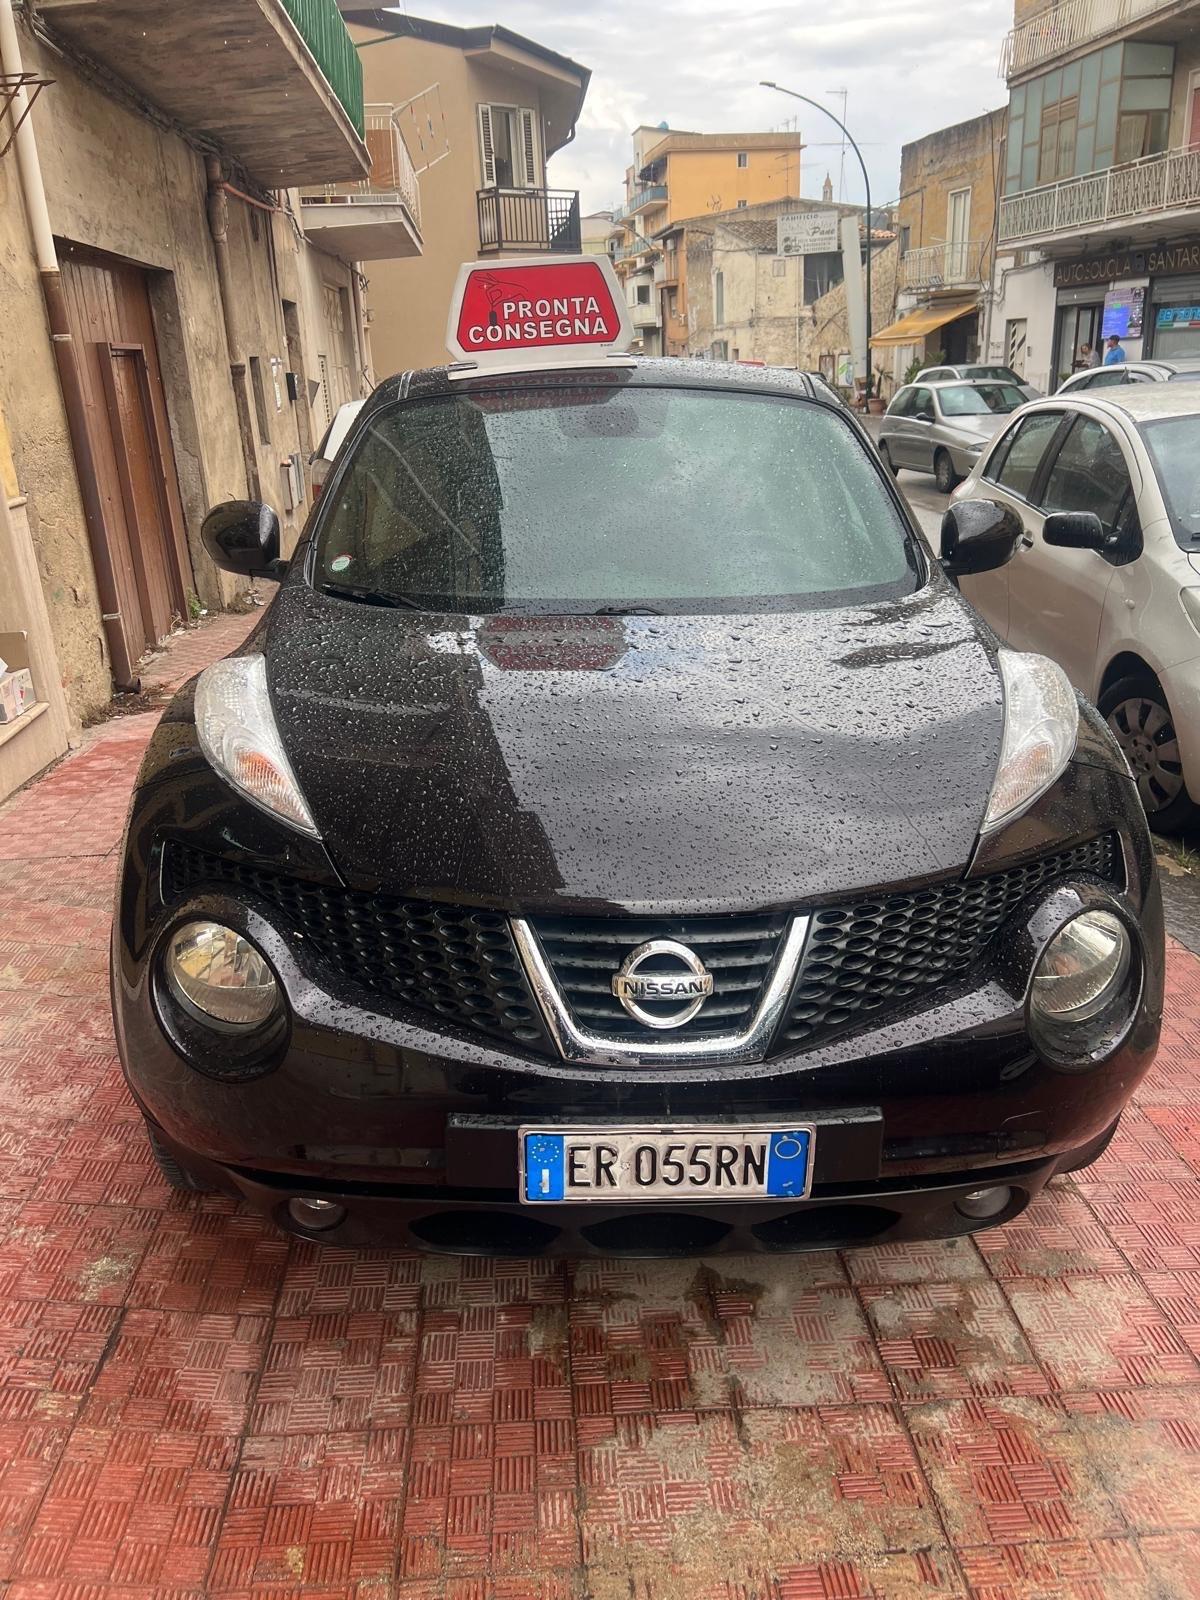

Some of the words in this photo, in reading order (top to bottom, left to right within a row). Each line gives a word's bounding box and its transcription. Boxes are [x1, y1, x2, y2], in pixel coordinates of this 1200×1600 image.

[503, 297, 600, 319] PRONTA
[468, 317, 608, 343] CONSEGNA
[624, 981, 703, 995] NISSAN
[568, 1145, 617, 1187] ER
[634, 1145, 766, 1187] 055RN
